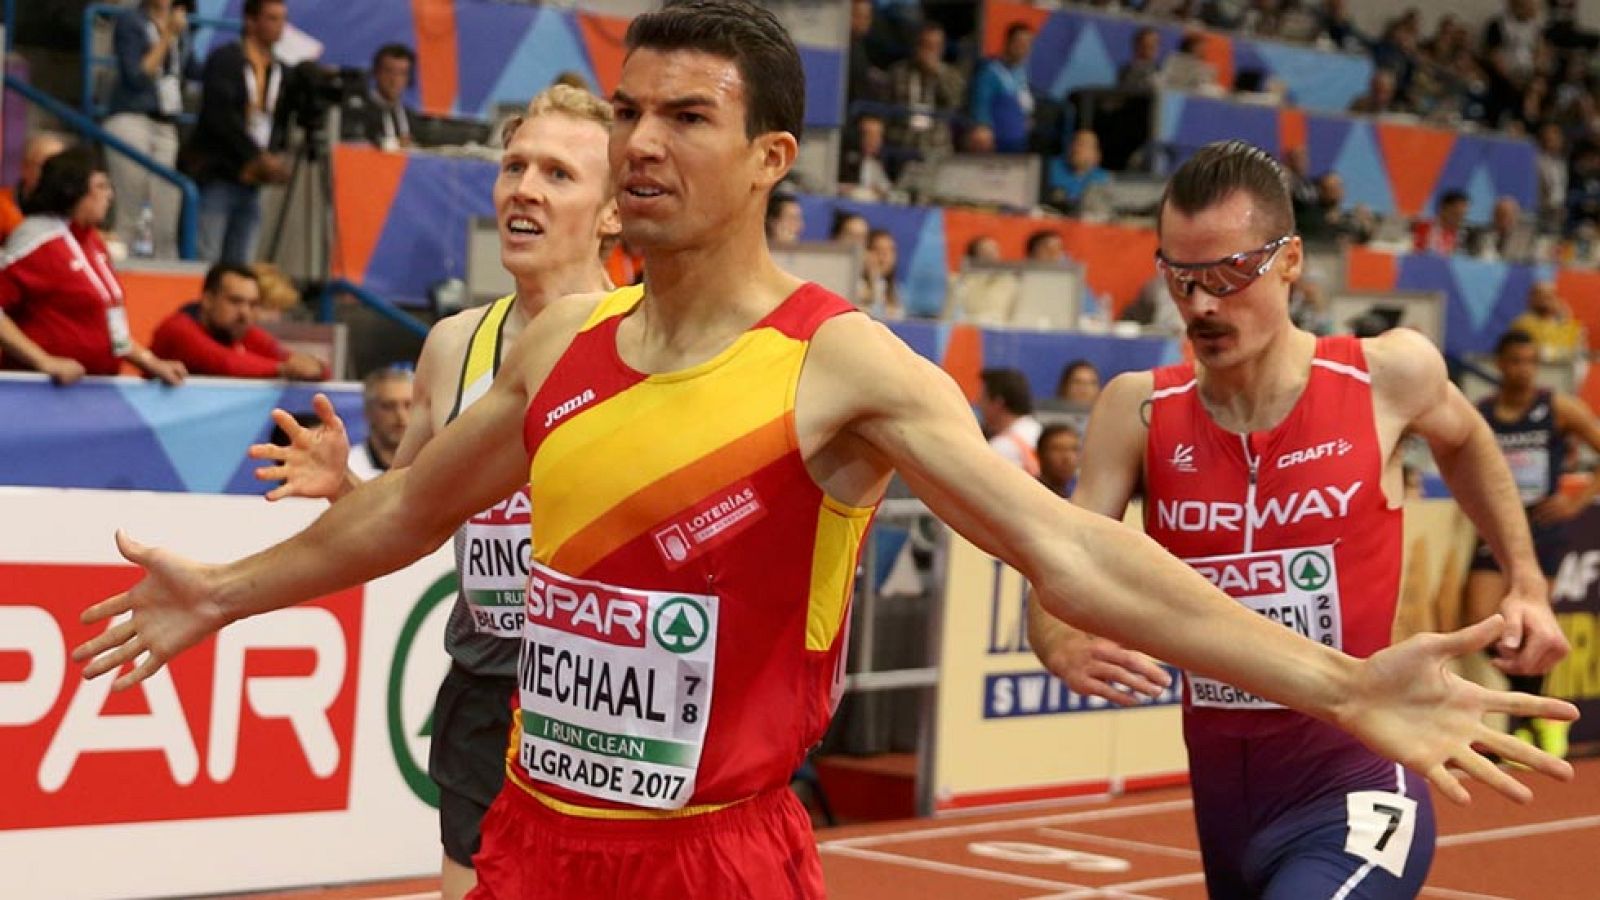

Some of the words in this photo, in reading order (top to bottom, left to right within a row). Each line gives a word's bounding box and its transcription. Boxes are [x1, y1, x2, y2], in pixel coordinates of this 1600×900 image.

[1276, 441, 1337, 470] CRAFT
[1157, 480, 1364, 533] NORWAY
[528, 576, 641, 641] SPAR
[522, 641, 666, 723] MECHAAL
[552, 722, 583, 747] RUN
[587, 732, 645, 758] CLEAN
[630, 770, 687, 801] 2017
[1372, 803, 1404, 852] 7
